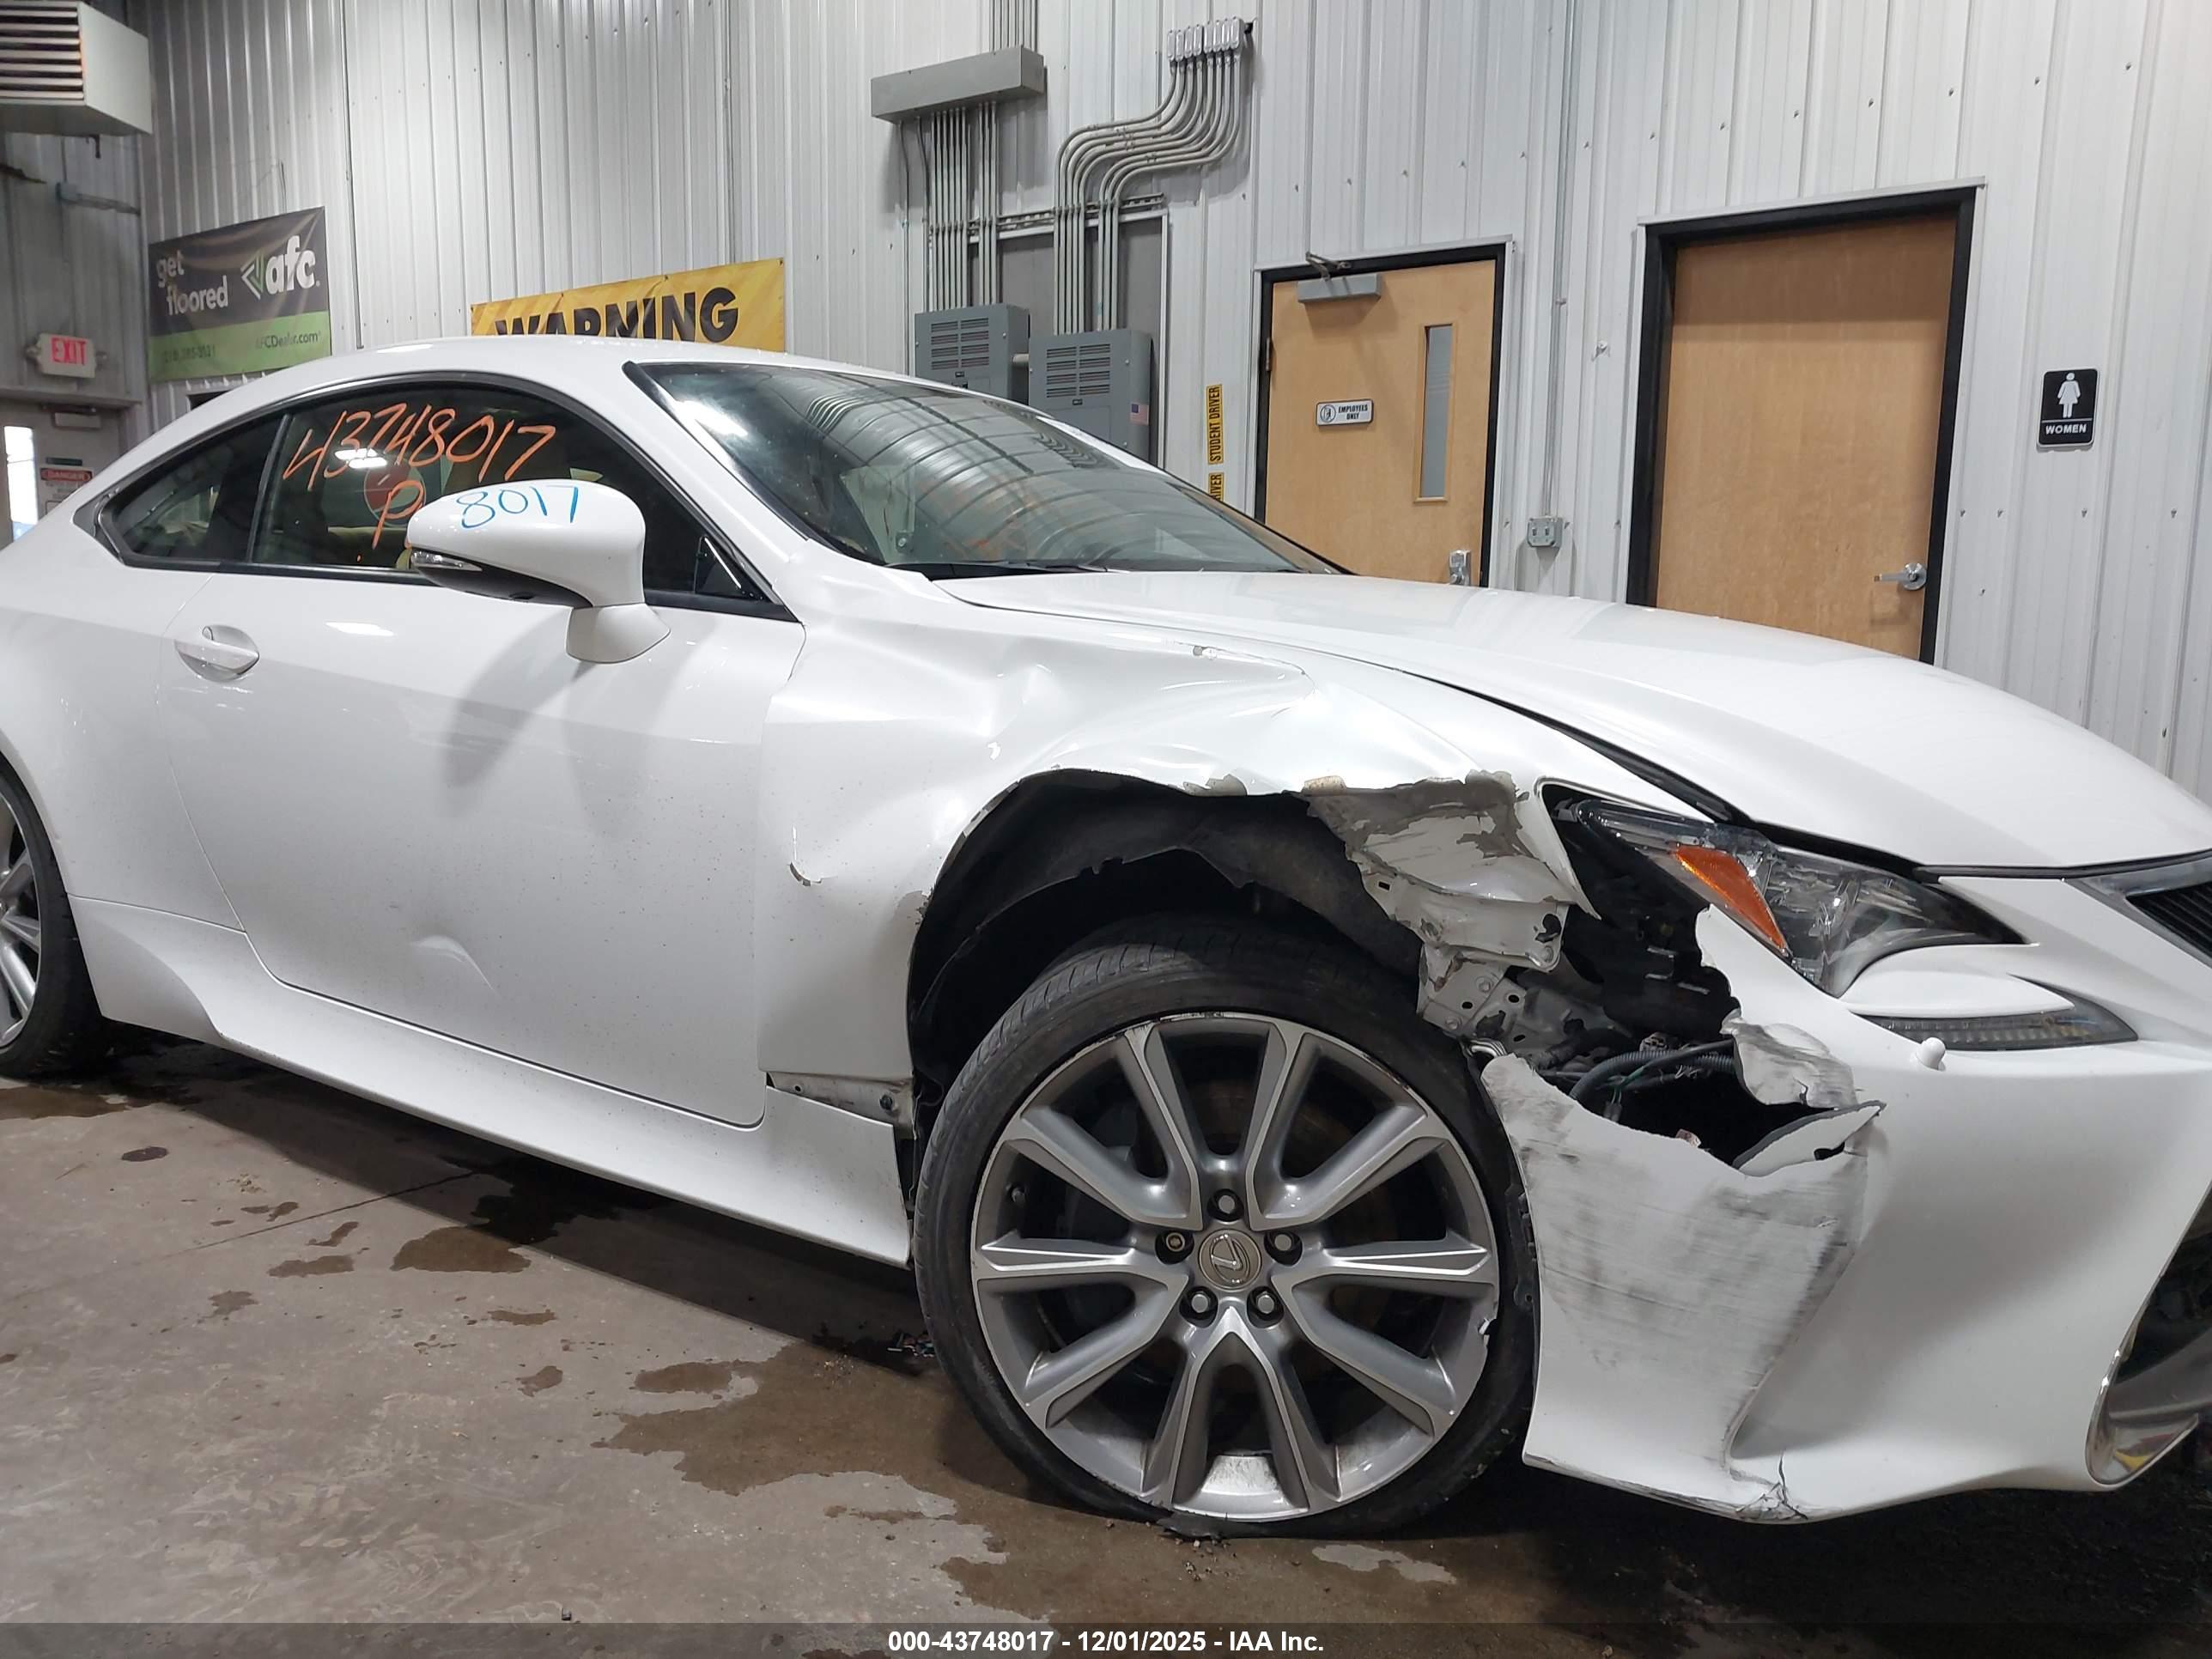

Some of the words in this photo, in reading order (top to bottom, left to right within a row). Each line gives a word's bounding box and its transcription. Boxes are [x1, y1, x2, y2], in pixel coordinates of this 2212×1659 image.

[156, 250, 185, 289] get
[265, 235, 317, 295] afc
[166, 275, 228, 316] floored
[51, 336, 88, 366] EXIT
[1208, 387, 1220, 419] DRIVER
[1338, 404, 1368, 413] EMPLOYEES
[283, 402, 556, 491] 43748017
[1209, 422, 1221, 461] STUDENT
[2045, 424, 2087, 434] WOMEN
[372, 480, 424, 550] P
[456, 486, 579, 528] 8017
